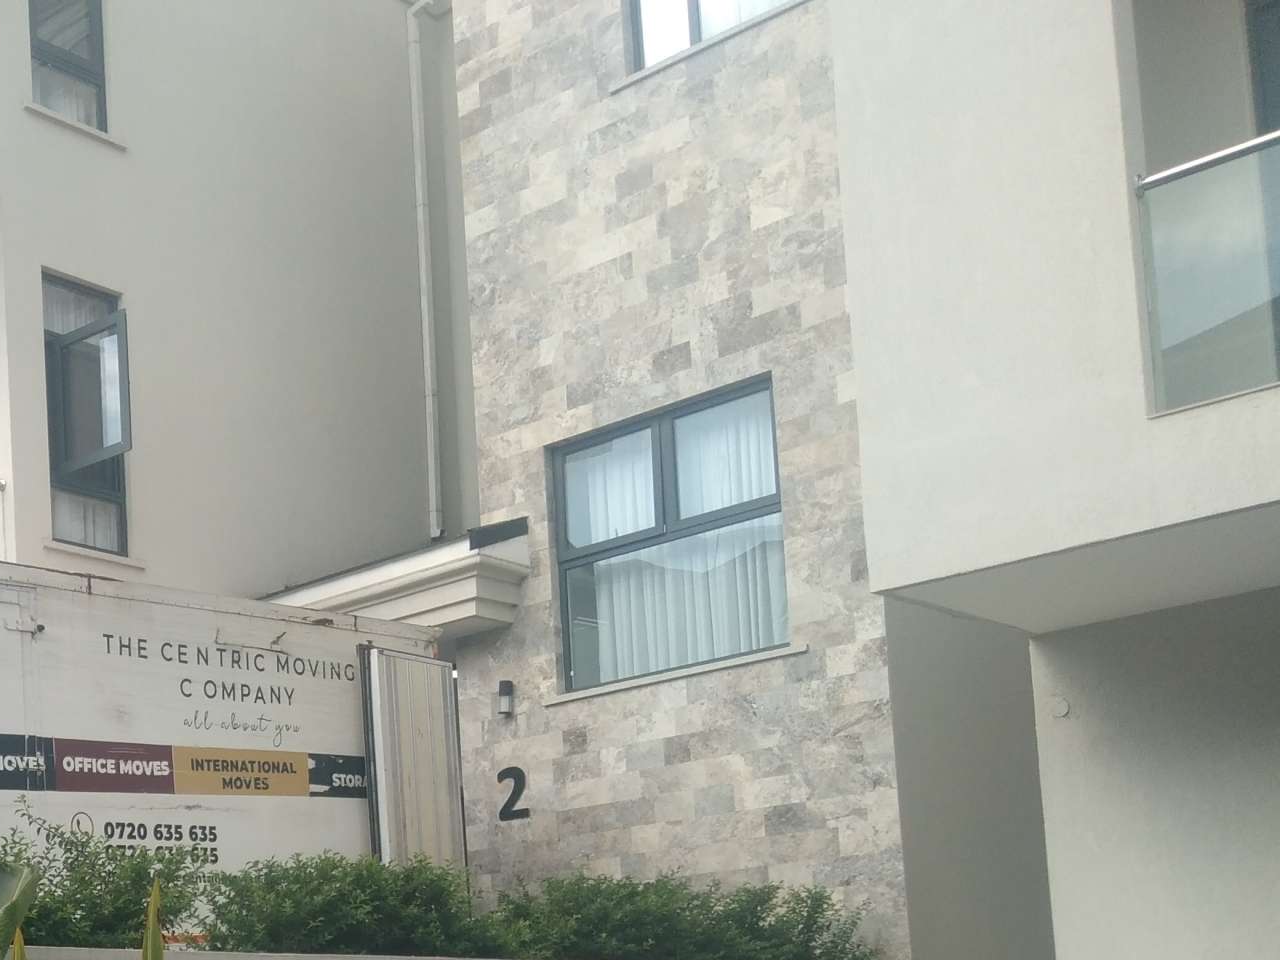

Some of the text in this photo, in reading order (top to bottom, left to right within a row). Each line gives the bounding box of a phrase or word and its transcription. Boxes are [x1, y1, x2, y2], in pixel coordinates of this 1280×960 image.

[102, 633, 355, 681] THE CENTRIC MOVING
[180, 678, 294, 705] COMPANY
[183, 710, 300, 748] all about you
[62, 756, 170, 776] OFFICE MOVES
[190, 758, 297, 774] INTERNATIONAL
[222, 777, 270, 790] MOVES
[496, 766, 530, 821] 2
[104, 822, 218, 842] 0720 635 635
